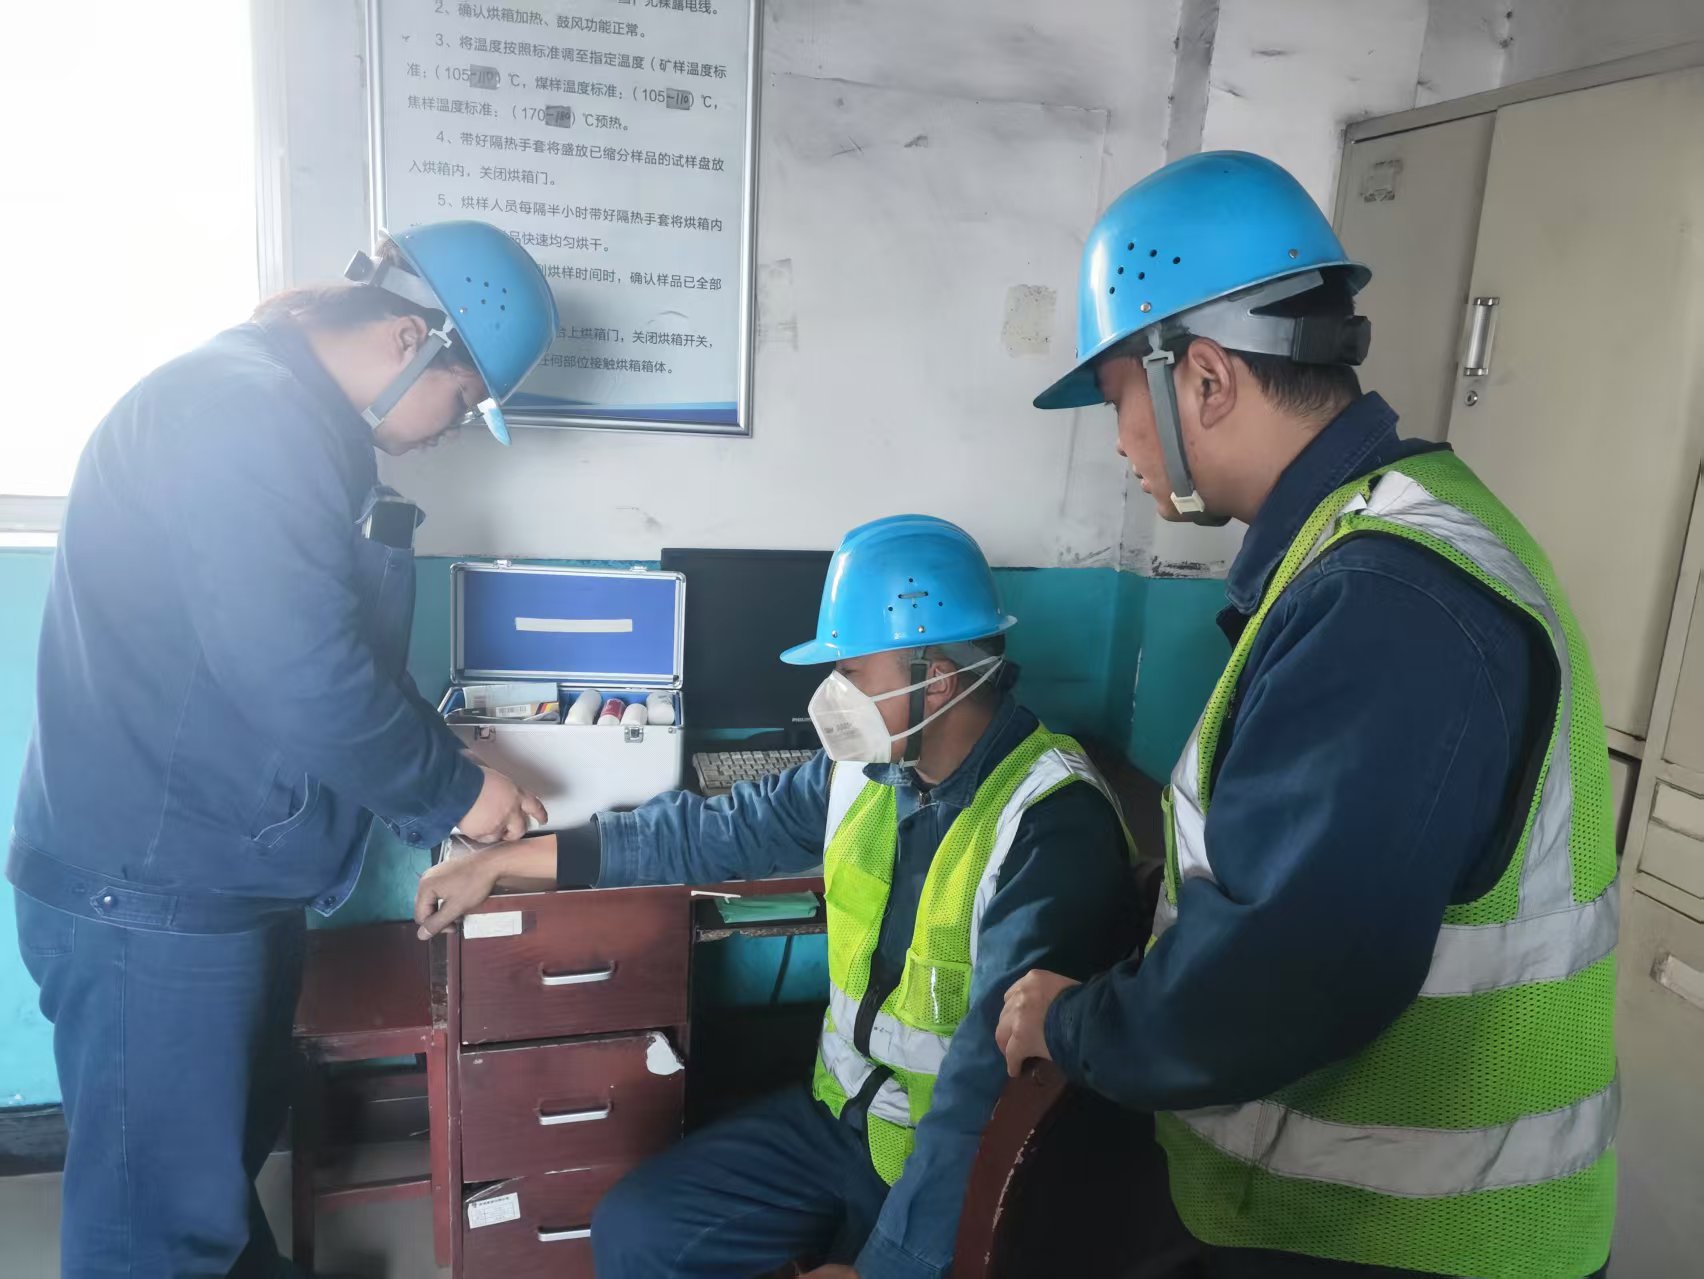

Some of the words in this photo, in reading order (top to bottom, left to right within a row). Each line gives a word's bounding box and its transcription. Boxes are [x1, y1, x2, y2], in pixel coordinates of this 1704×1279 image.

[436, 130, 725, 172] 4、带好隔热手套将盛放已缩分样品的试样盘放
[437, 193, 723, 232] 5、烘样人员每隔半小时带好隔热手套将烘箱内
